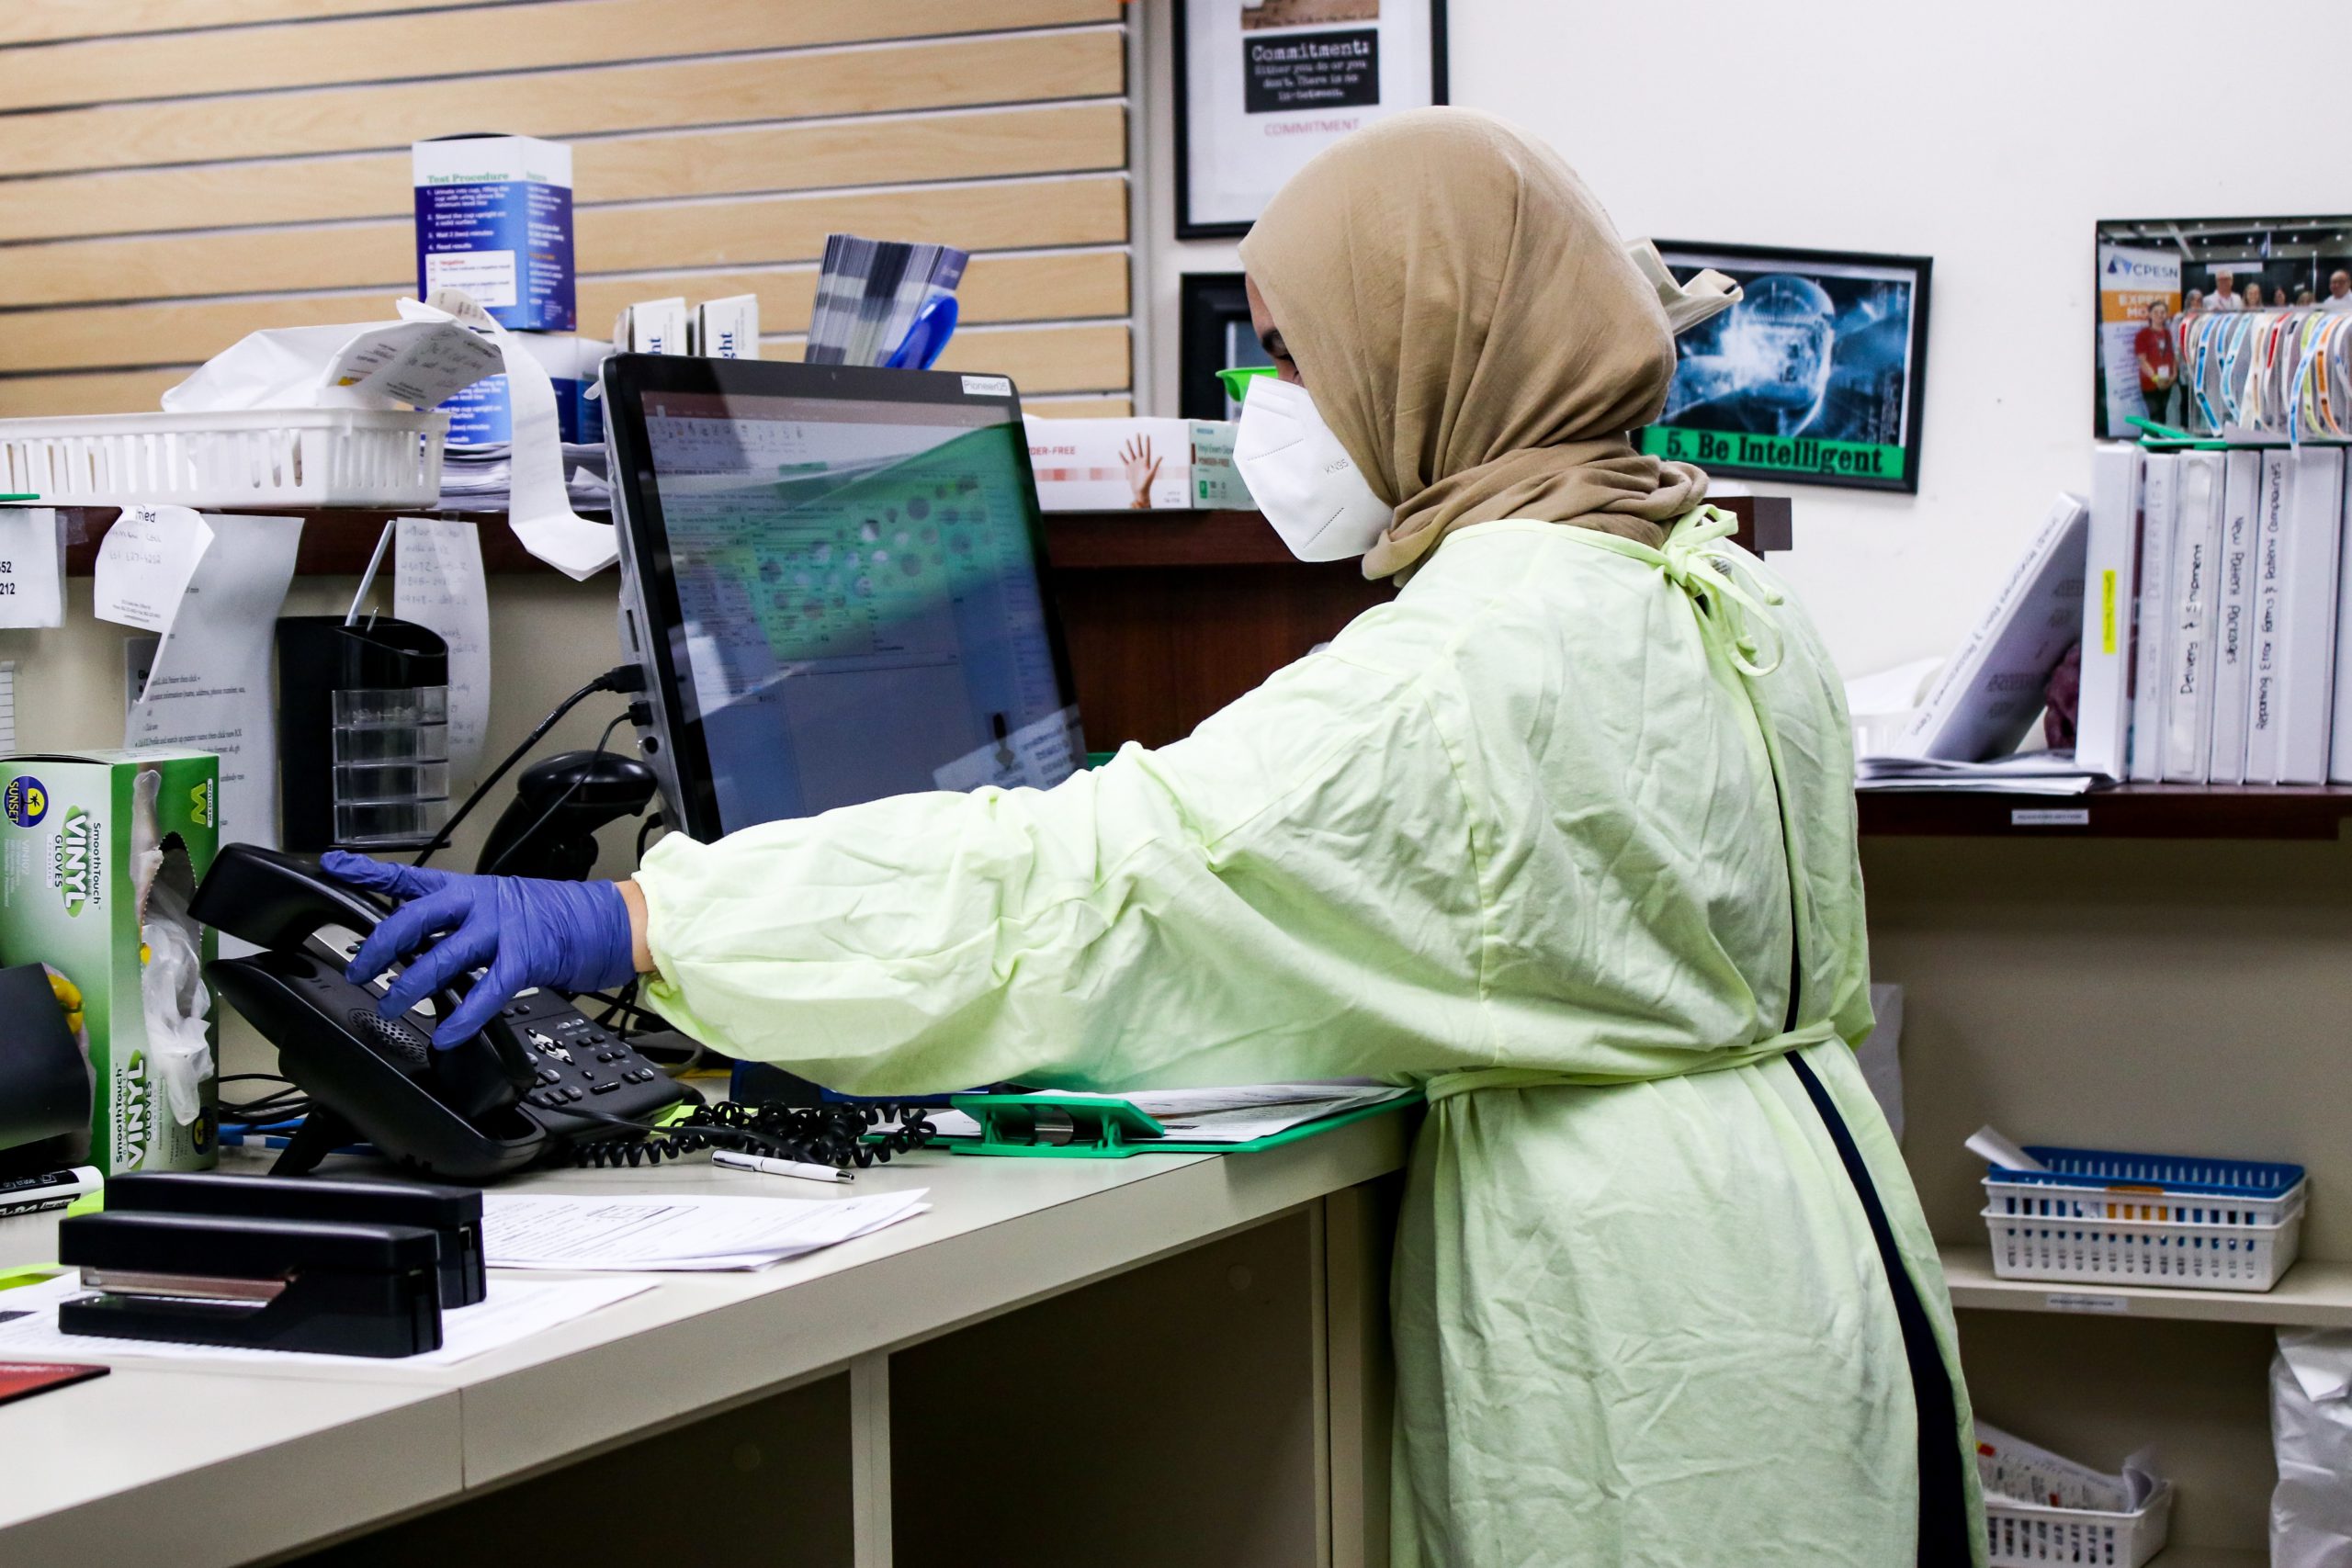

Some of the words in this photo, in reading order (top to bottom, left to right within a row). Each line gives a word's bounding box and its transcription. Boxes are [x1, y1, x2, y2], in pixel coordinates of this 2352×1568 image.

[1264, 118, 1361, 136] COMMITMENT
[427, 175, 449, 183] Test
[452, 172, 509, 182] Procedure
[1028, 446, 1076, 456] DER-FREE
[1324, 458, 1349, 475] KN95
[1666, 431, 1689, 458] 5.
[1696, 434, 1730, 460] Be
[1738, 433, 1883, 475] Intelligent
[2267, 462, 2281, 533] Complaints
[2232, 515, 2244, 546] New
[0, 560, 12, 573] 52
[2230, 552, 2245, 595] Patient
[2265, 538, 2277, 580] Patient
[2180, 641, 2198, 694] Delivery
[2259, 641, 2272, 671] Error
[2256, 677, 2272, 730] Reporting
[8, 781, 19, 823] SUNSET
[191, 783, 207, 825] M
[55, 834, 63, 887] GLOVES
[65, 815, 87, 908] VINYL
[127, 1059, 144, 1169] VINYL
